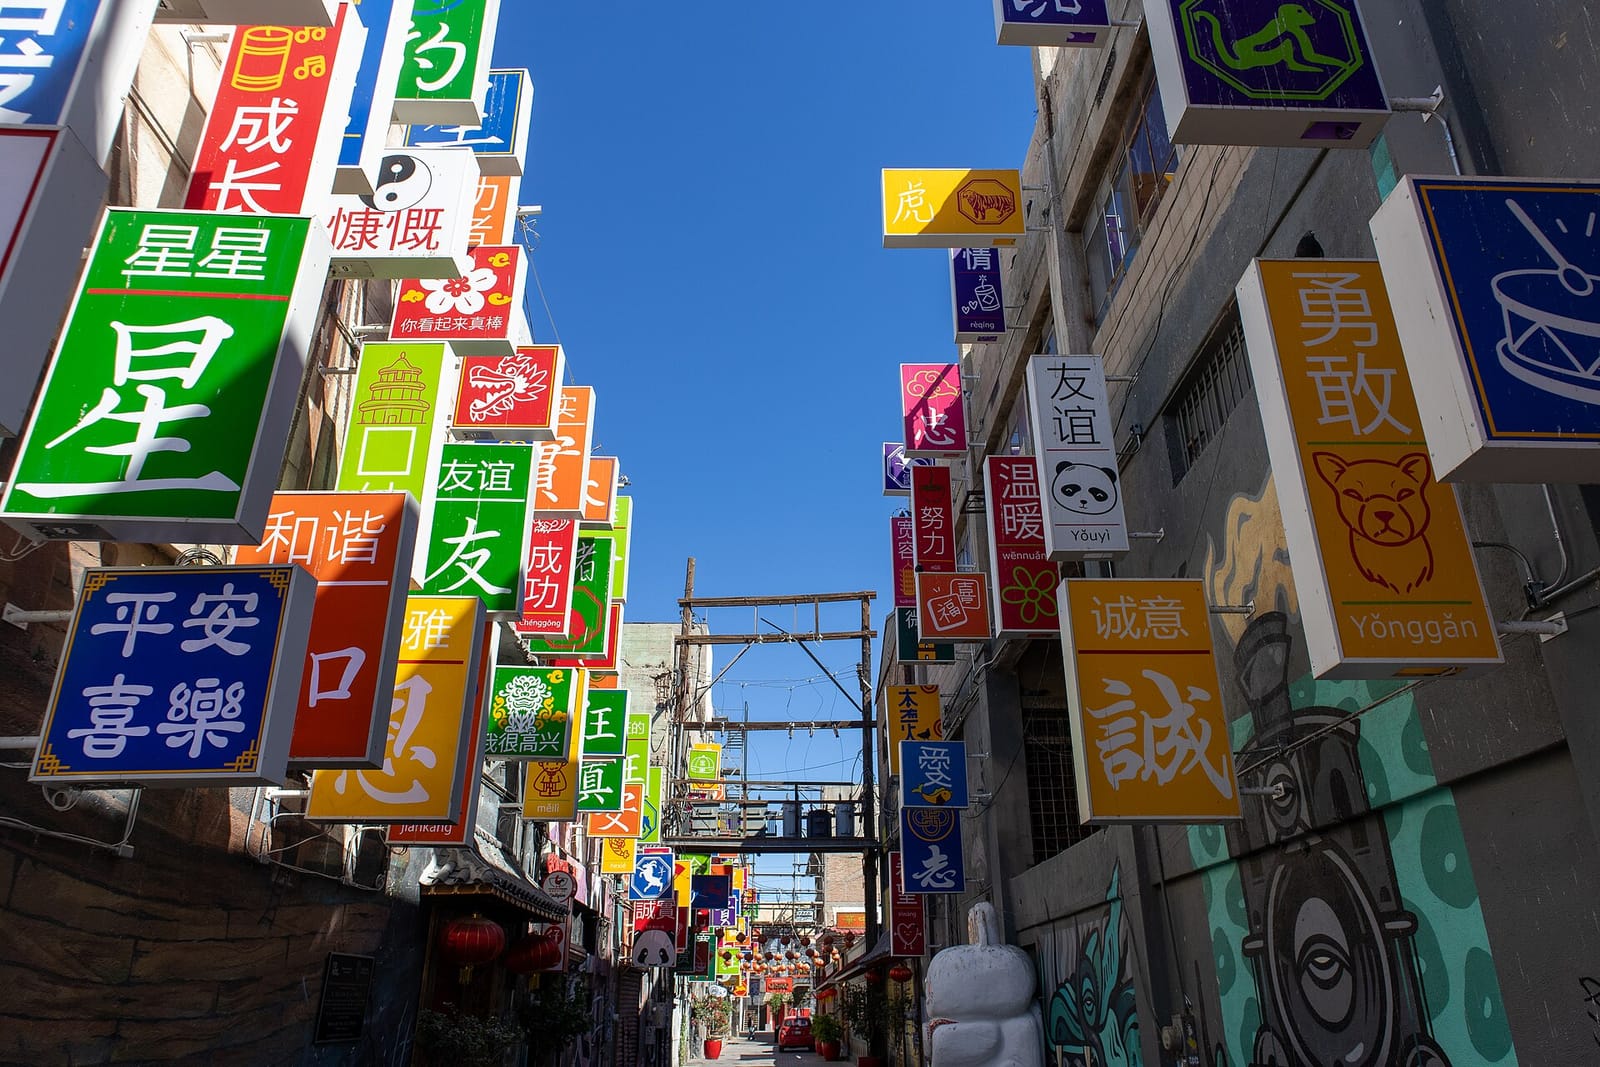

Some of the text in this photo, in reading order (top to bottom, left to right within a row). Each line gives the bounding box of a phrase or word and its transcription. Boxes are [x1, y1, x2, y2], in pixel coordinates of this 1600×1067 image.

[210, 97, 298, 213] 成长
[892, 179, 934, 224] 虎
[121, 224, 271, 280] 星星
[327, 207, 444, 250] 慷慨
[401, 316, 503, 332] 你看起来真棒
[1292, 272, 1412, 436] 勇敢
[15, 316, 241, 498] 星
[914, 407, 957, 445] 忠
[1047, 362, 1100, 445] 友谊
[437, 459, 514, 493] 友谊
[1000, 463, 1044, 540] 温暖
[256, 510, 385, 565] 和谐
[920, 506, 945, 555] 努力
[424, 517, 512, 595] 友
[525, 541, 563, 608] 成功
[937, 599, 961, 624] 福
[958, 582, 976, 604] 喜
[1091, 595, 1188, 640] 诚意
[90, 582, 260, 657] 平安
[401, 608, 453, 650] 雅
[67, 674, 246, 758] 喜樂
[1086, 669, 1233, 799] 誠
[485, 732, 560, 753] 我很高兴
[919, 746, 952, 788] 愛
[911, 845, 957, 888] 志
